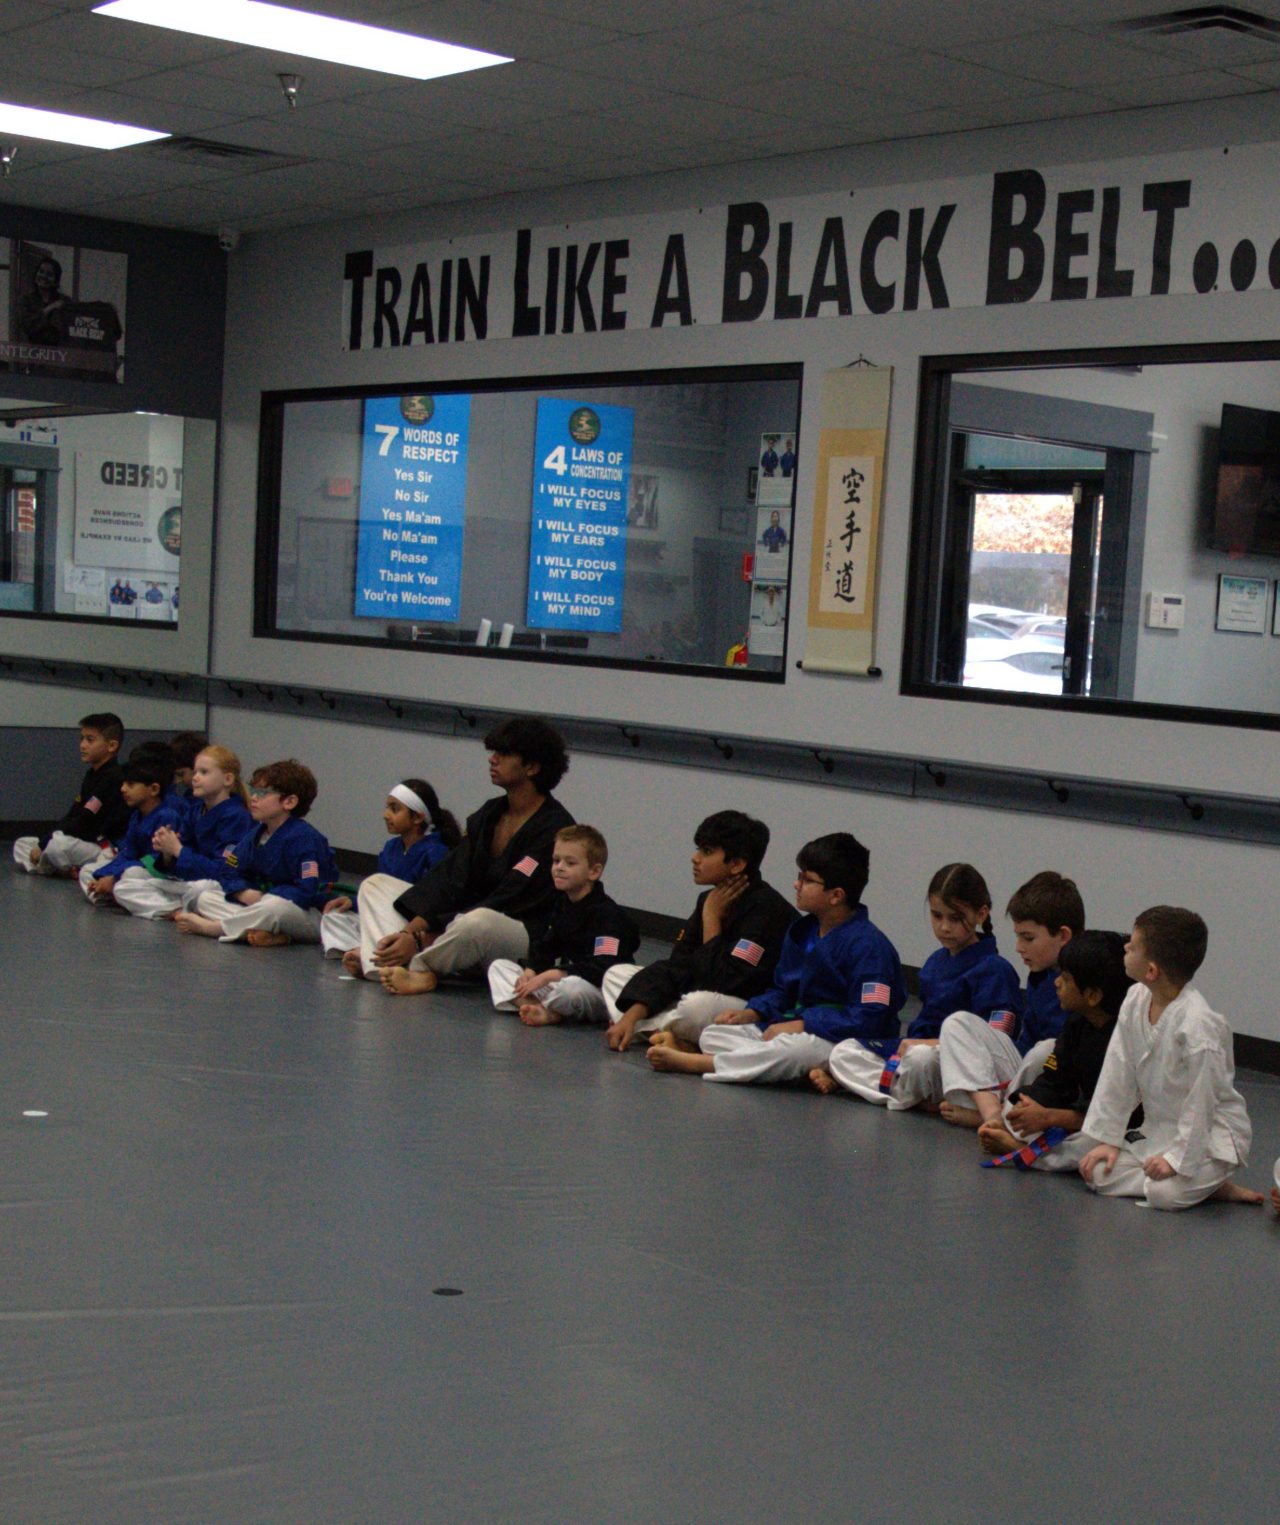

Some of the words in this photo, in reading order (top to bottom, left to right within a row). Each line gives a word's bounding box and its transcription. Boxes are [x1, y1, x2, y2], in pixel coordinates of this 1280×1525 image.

[344, 250, 490, 350] TRAIN
[512, 229, 630, 338] LIKE
[651, 233, 692, 328] A
[722, 201, 957, 323] BLACK
[375, 424, 399, 456] 7
[403, 428, 442, 444] WORDS
[445, 432, 459, 447] OF
[402, 445, 458, 464] RESPECT
[543, 445, 567, 476] 4
[572, 448, 605, 463] LAWS
[608, 451, 623, 465] OF
[394, 468, 415, 482] Yes
[417, 471, 433, 483] Sir
[570, 464, 622, 481] CONCENTRATION
[395, 490, 410, 502] No
[413, 491, 429, 503] Sir
[547, 485, 577, 496] WILL
[580, 488, 621, 501] FOCUS
[553, 498, 573, 508] MY
[575, 500, 607, 511] EYES
[382, 508, 402, 522] Yes
[405, 511, 441, 525] Ma'am
[545, 520, 575, 532] WILL
[578, 523, 619, 536] FOCUS
[834, 468, 865, 603] 空手道
[382, 529, 398, 541] No
[401, 531, 437, 545] Ma'am
[551, 533, 571, 544] MY
[573, 535, 605, 547] EARS
[390, 550, 428, 564] Please
[544, 556, 573, 568] WILL
[576, 559, 617, 571] FOCUS
[379, 569, 414, 583] Thank
[417, 572, 438, 585] You
[549, 569, 568, 580] MY
[571, 570, 604, 582] BODY
[363, 589, 398, 603] You're
[401, 591, 451, 606] Welcome
[542, 592, 571, 603] WILL
[575, 594, 615, 606] FOCUS
[548, 604, 566, 615] MY
[569, 605, 601, 617] MIND
